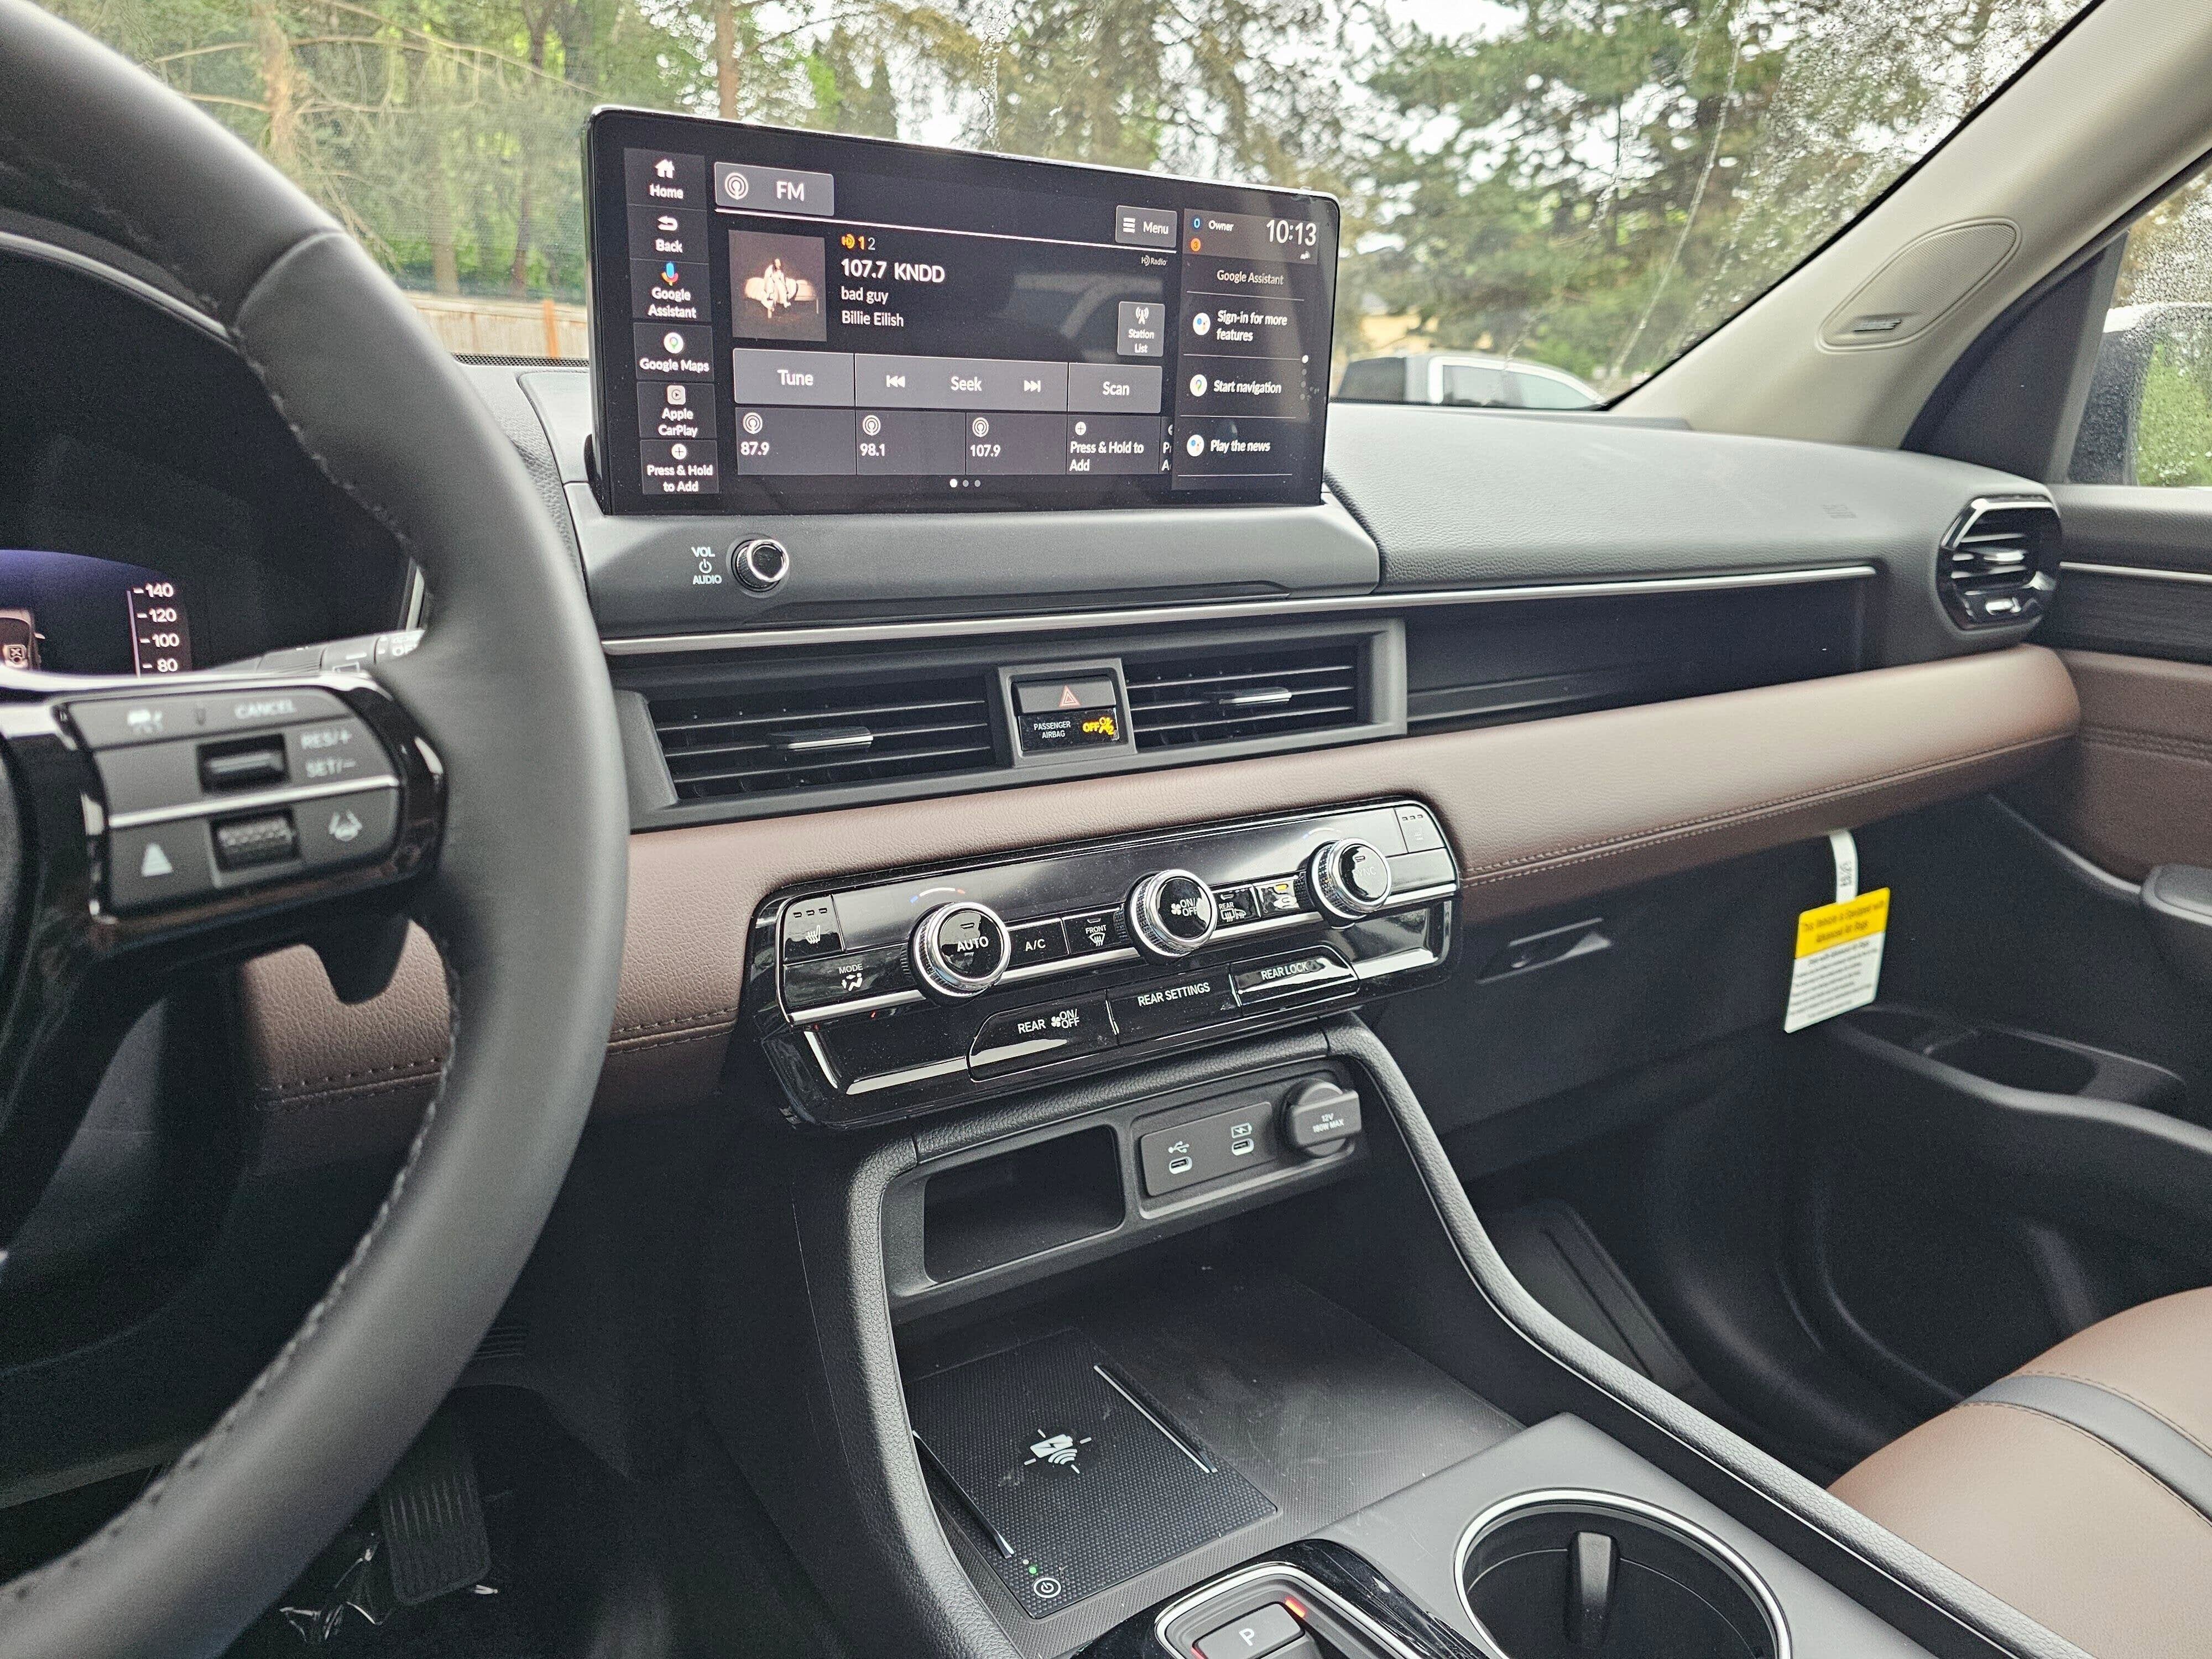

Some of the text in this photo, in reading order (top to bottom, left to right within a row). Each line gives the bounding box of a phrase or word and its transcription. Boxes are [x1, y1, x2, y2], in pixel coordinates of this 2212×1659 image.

[649, 184, 684, 200] Home
[776, 181, 805, 202] FM
[1142, 221, 1169, 234] Menu
[1208, 220, 1234, 232] Owner
[1266, 219, 1317, 247] 10:13
[655, 239, 683, 253] Back
[858, 236, 865, 250] 1
[868, 237, 875, 250] 2
[1150, 257, 1166, 266] Radio
[841, 258, 945, 283] 107.7 KNDD
[1217, 269, 1284, 285] Google Assistant
[651, 286, 691, 304] Google
[841, 285, 889, 305] bad guy
[648, 304, 697, 319] Assistant
[842, 310, 904, 327] Billie Eilish
[1217, 310, 1288, 326] Sign-in for more
[1128, 328, 1154, 340] Station
[1216, 327, 1254, 342] features
[1134, 343, 1148, 353] List
[639, 358, 709, 374] Google Maps
[777, 369, 814, 387] Tune
[951, 375, 982, 392] Seek
[1102, 381, 1130, 396] Scan
[1213, 380, 1282, 395] Start navigation
[661, 408, 694, 421] Apple
[658, 424, 698, 438] CarPlay
[740, 441, 770, 456] 87.9
[860, 443, 885, 456] 98.1
[970, 444, 1001, 457] 107.9
[1070, 441, 1144, 454] Press & Hold to
[1210, 439, 1271, 454] Play the news
[646, 464, 713, 476] Press & Hold
[1069, 459, 1091, 472] Add
[663, 481, 699, 492] to Add
[691, 546, 716, 557] VOL
[692, 575, 722, 585] AUDIO
[145, 582, 174, 598] 140
[148, 607, 178, 623] 120
[152, 633, 180, 648] 100
[156, 658, 179, 672] 80
[234, 698, 298, 719] CANCEL
[1033, 720, 1100, 733] PASSENGER OFF
[1041, 729, 1066, 739] AIRBAG
[1218, 901, 1235, 910] REAR
[1085, 924, 1107, 934] FRONT
[956, 936, 989, 952] AUTO
[1025, 938, 1046, 952] A/C
[838, 963, 864, 975] MODE
[1261, 962, 1308, 980] REAR LOCK
[1138, 982, 1211, 1007] REAR SETTINGS
[1017, 1019, 1047, 1034] REAR
[1061, 1016, 1080, 1029] OFF
[1329, 1118, 1345, 1129] MAX
[1238, 1627, 1255, 1647] P
